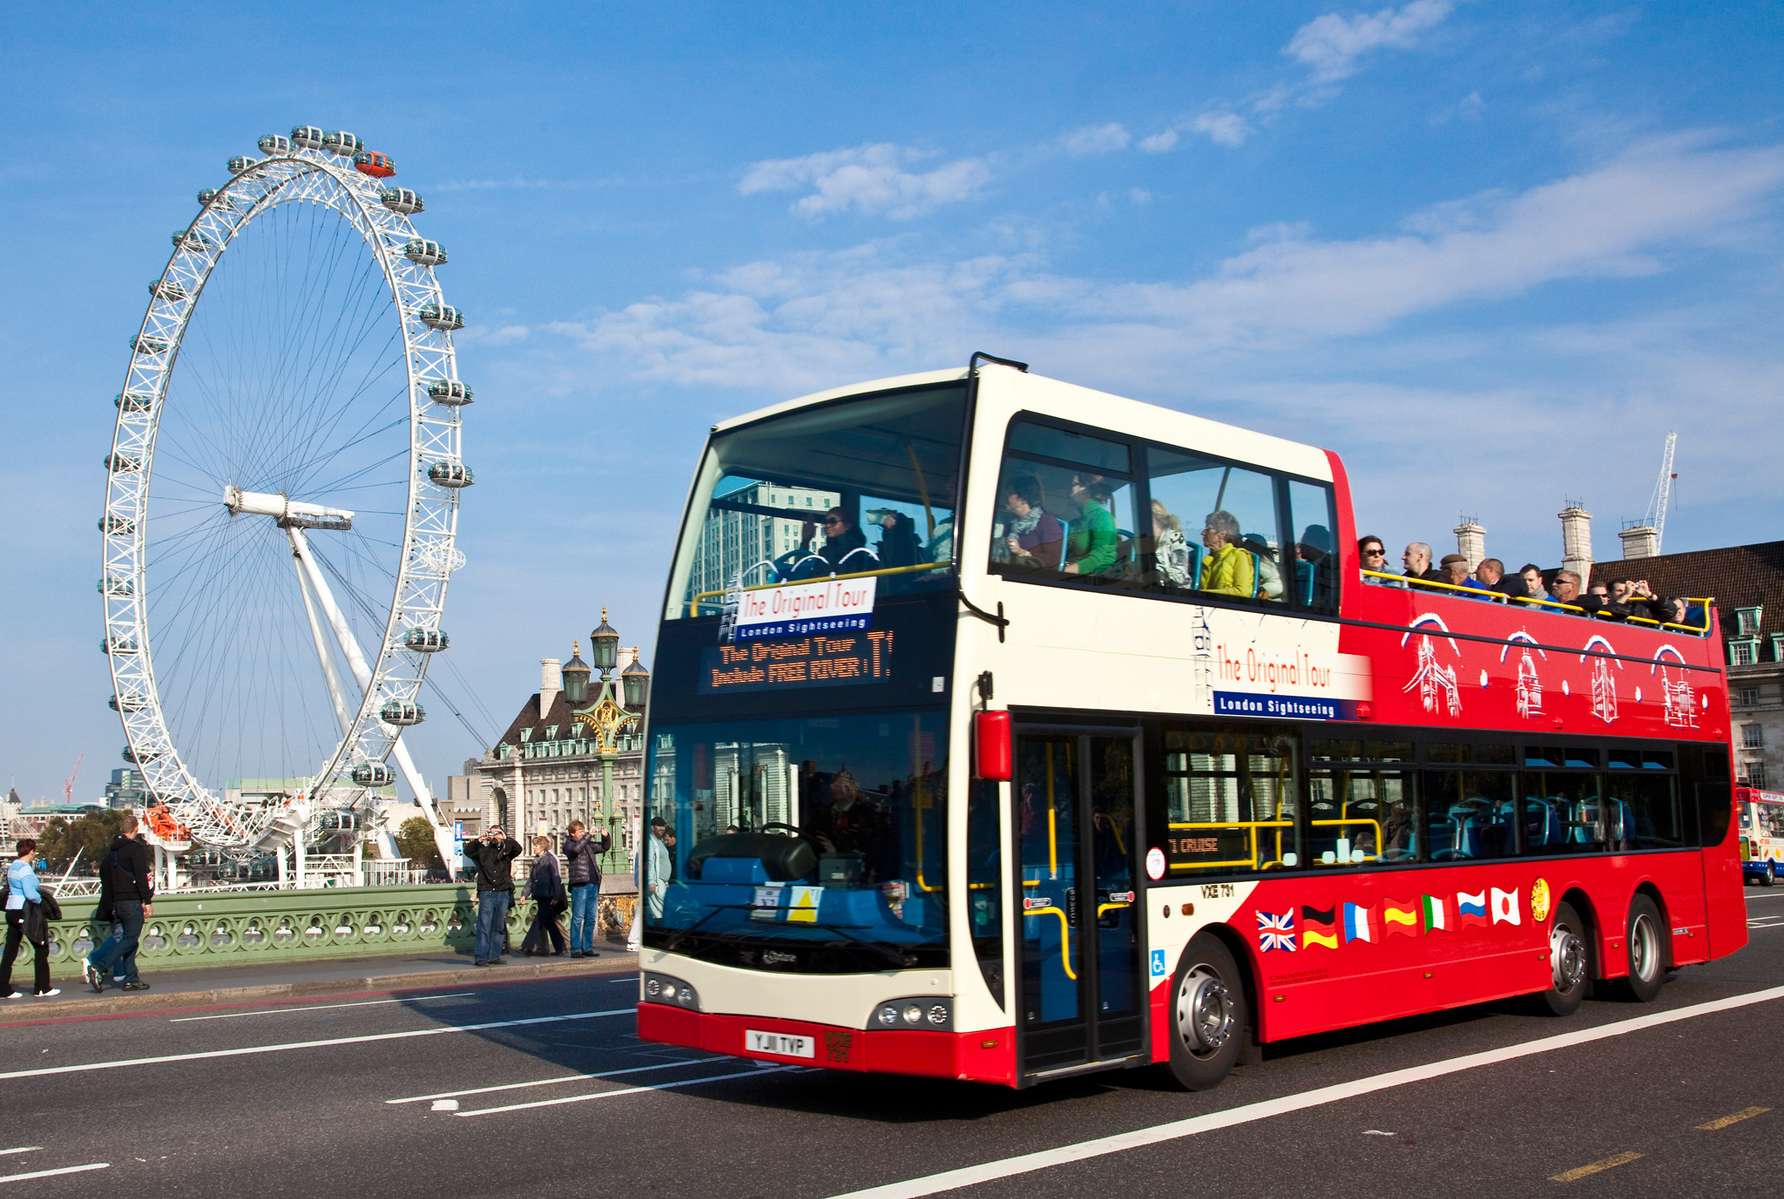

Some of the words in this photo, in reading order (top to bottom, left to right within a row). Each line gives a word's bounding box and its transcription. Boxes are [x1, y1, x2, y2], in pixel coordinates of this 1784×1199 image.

[743, 593, 766, 618] The
[772, 582, 831, 618] Original
[834, 582, 868, 608] Tour
[741, 625, 783, 638] London
[788, 618, 867, 633] Sightseeing
[719, 645, 749, 665] The
[813, 636, 856, 656] Tour
[767, 661, 807, 682] FREE
[810, 657, 861, 679] RIVER
[1217, 643, 1241, 681] The
[1247, 647, 1301, 693] Original
[1304, 652, 1331, 688] Tour
[1220, 697, 1263, 711] London
[1267, 699, 1335, 718] Sightseeing
